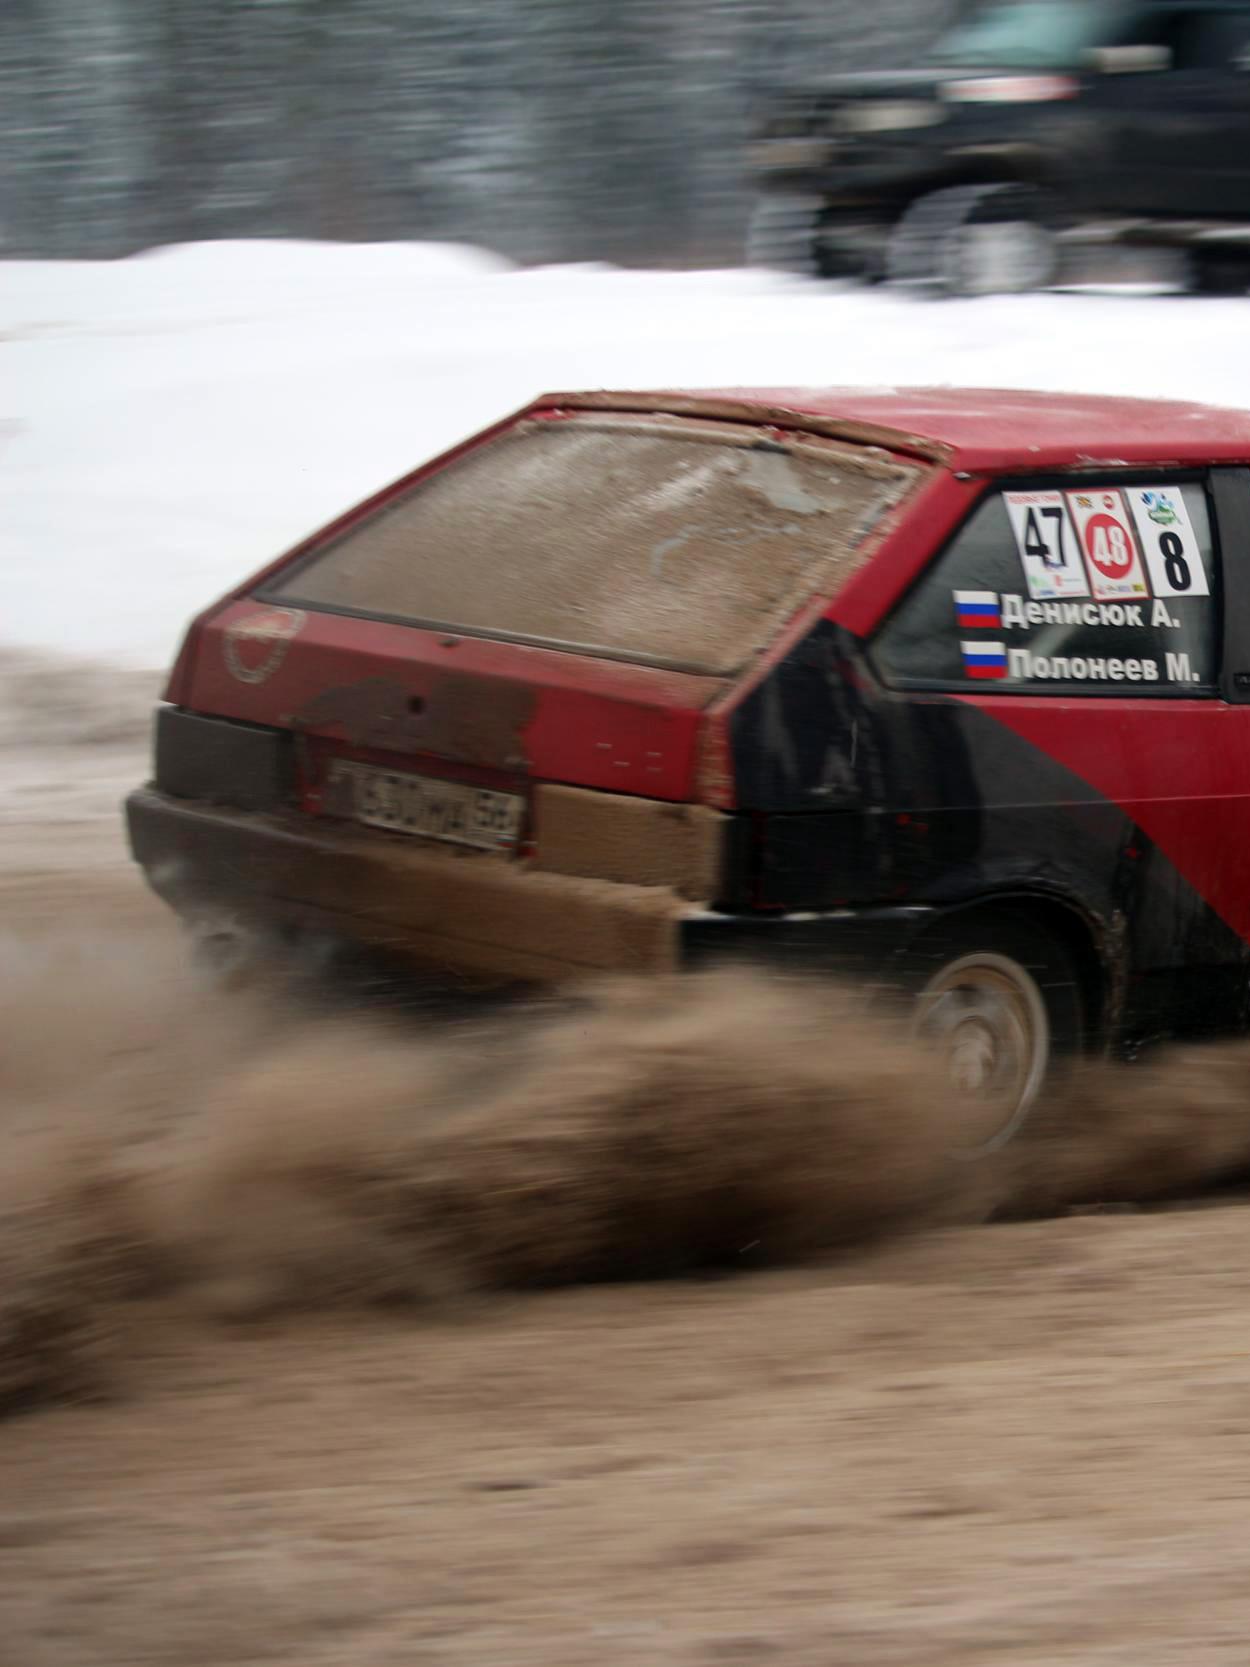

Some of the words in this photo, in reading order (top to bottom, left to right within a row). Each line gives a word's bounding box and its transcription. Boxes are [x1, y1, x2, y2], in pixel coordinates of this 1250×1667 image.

[1024, 506, 1066, 568] 47
[1093, 526, 1128, 568] 48
[1159, 531, 1192, 591] 8
[1001, 594, 1145, 629] Денисюк
[1008, 649, 1160, 681] Полонеев
